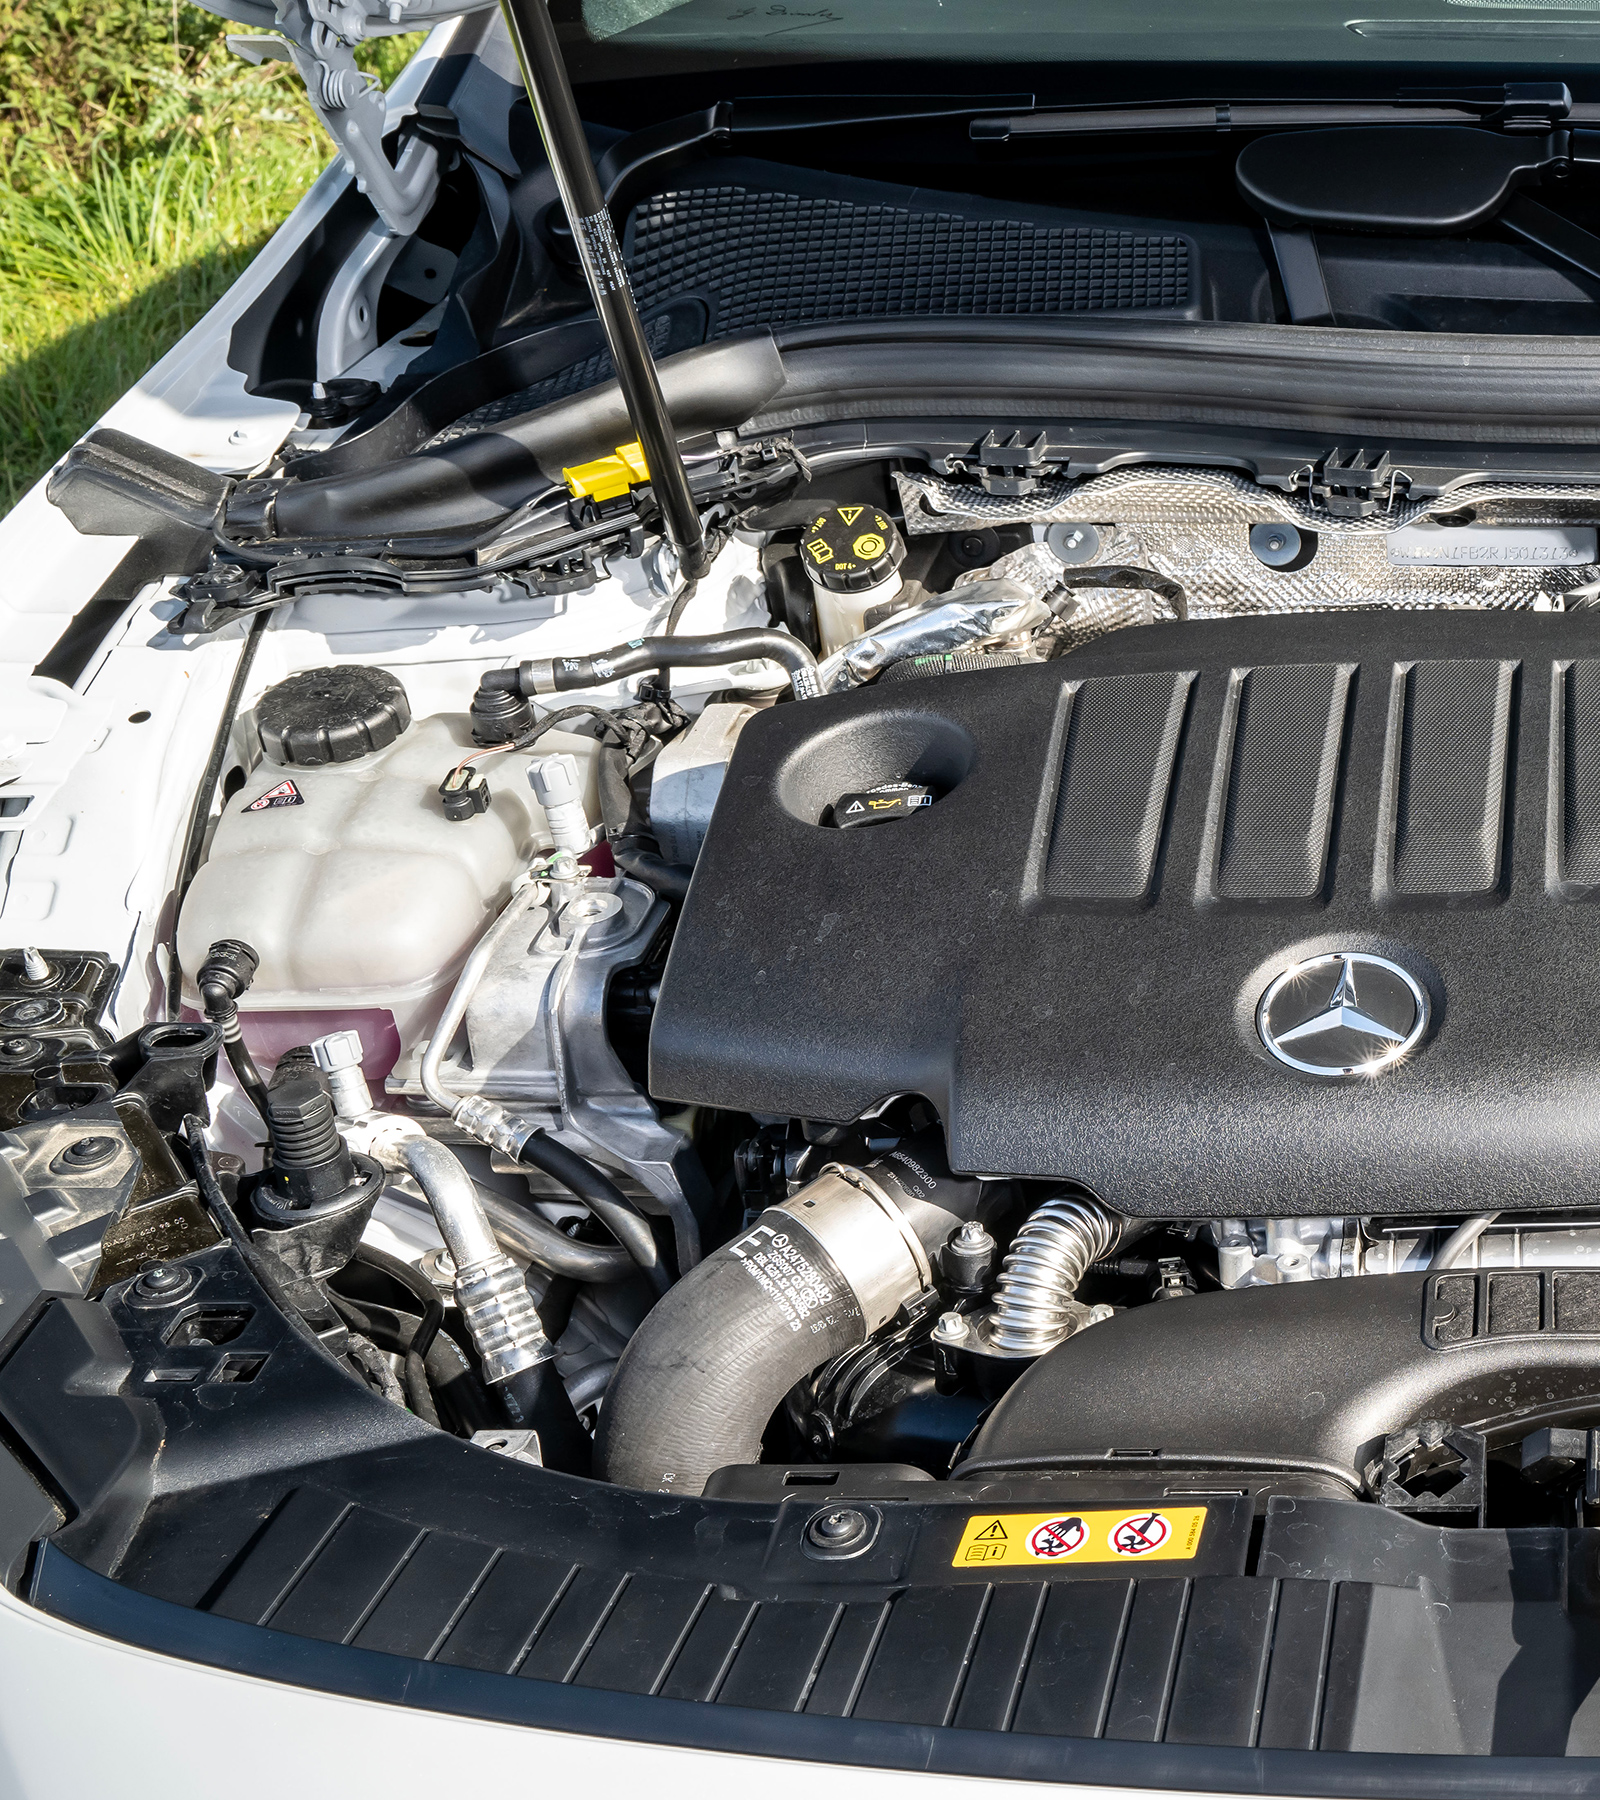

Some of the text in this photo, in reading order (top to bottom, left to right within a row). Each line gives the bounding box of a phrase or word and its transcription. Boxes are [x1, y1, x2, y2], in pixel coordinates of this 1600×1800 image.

[834, 563, 847, 571] DOT
[913, 1185, 925, 1198] Q02
[729, 1225, 777, 1258] E
[780, 1245, 833, 1306] A2475280482
